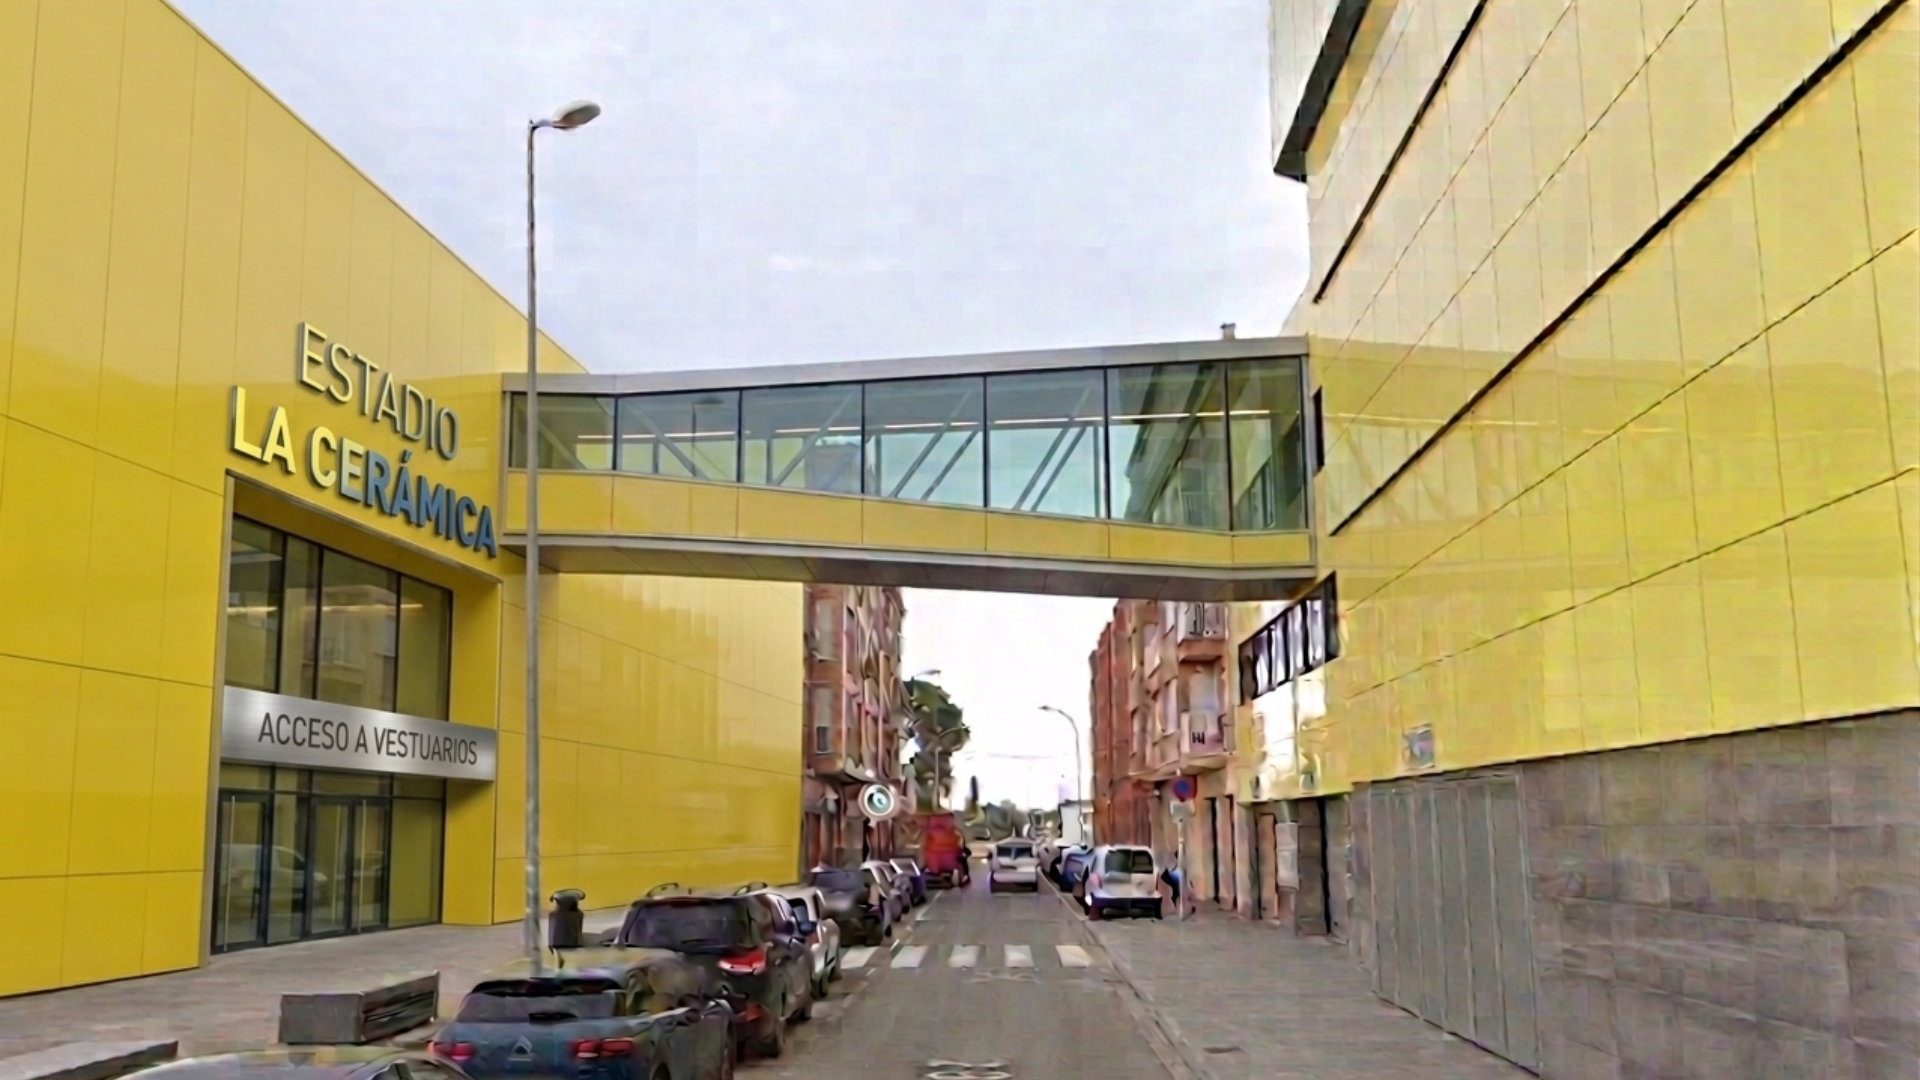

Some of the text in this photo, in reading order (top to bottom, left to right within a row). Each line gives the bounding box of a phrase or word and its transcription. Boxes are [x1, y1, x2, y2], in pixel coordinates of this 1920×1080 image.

[298, 321, 458, 460] ESTADIO
[230, 385, 497, 558] LA CERÁMICA
[258, 712, 478, 766] ACCESO A VESTUARIOS
